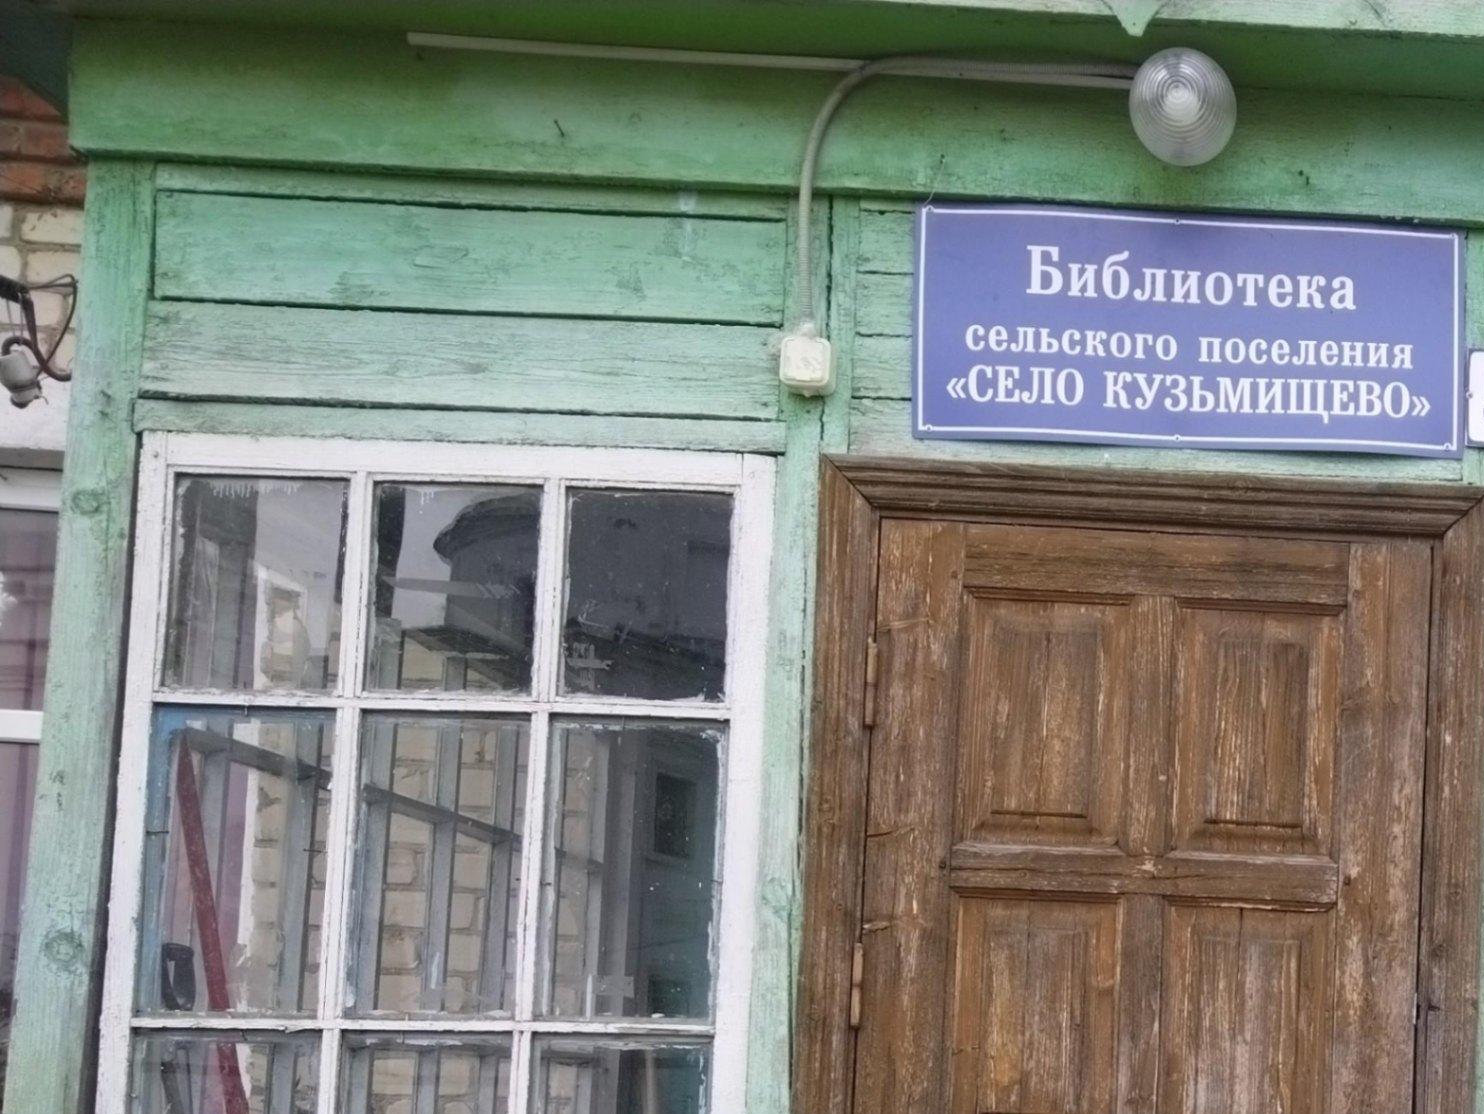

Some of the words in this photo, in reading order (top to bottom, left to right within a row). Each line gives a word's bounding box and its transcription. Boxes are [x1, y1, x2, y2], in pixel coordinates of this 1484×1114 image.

[1025, 245, 1358, 310] Библиотека
[964, 322, 1178, 361] сельского
[1197, 335, 1414, 370] поселения
[946, 364, 1085, 405] «СЕЛО
[1104, 370, 1431, 423] КУЗЬМИЩЕВО»
